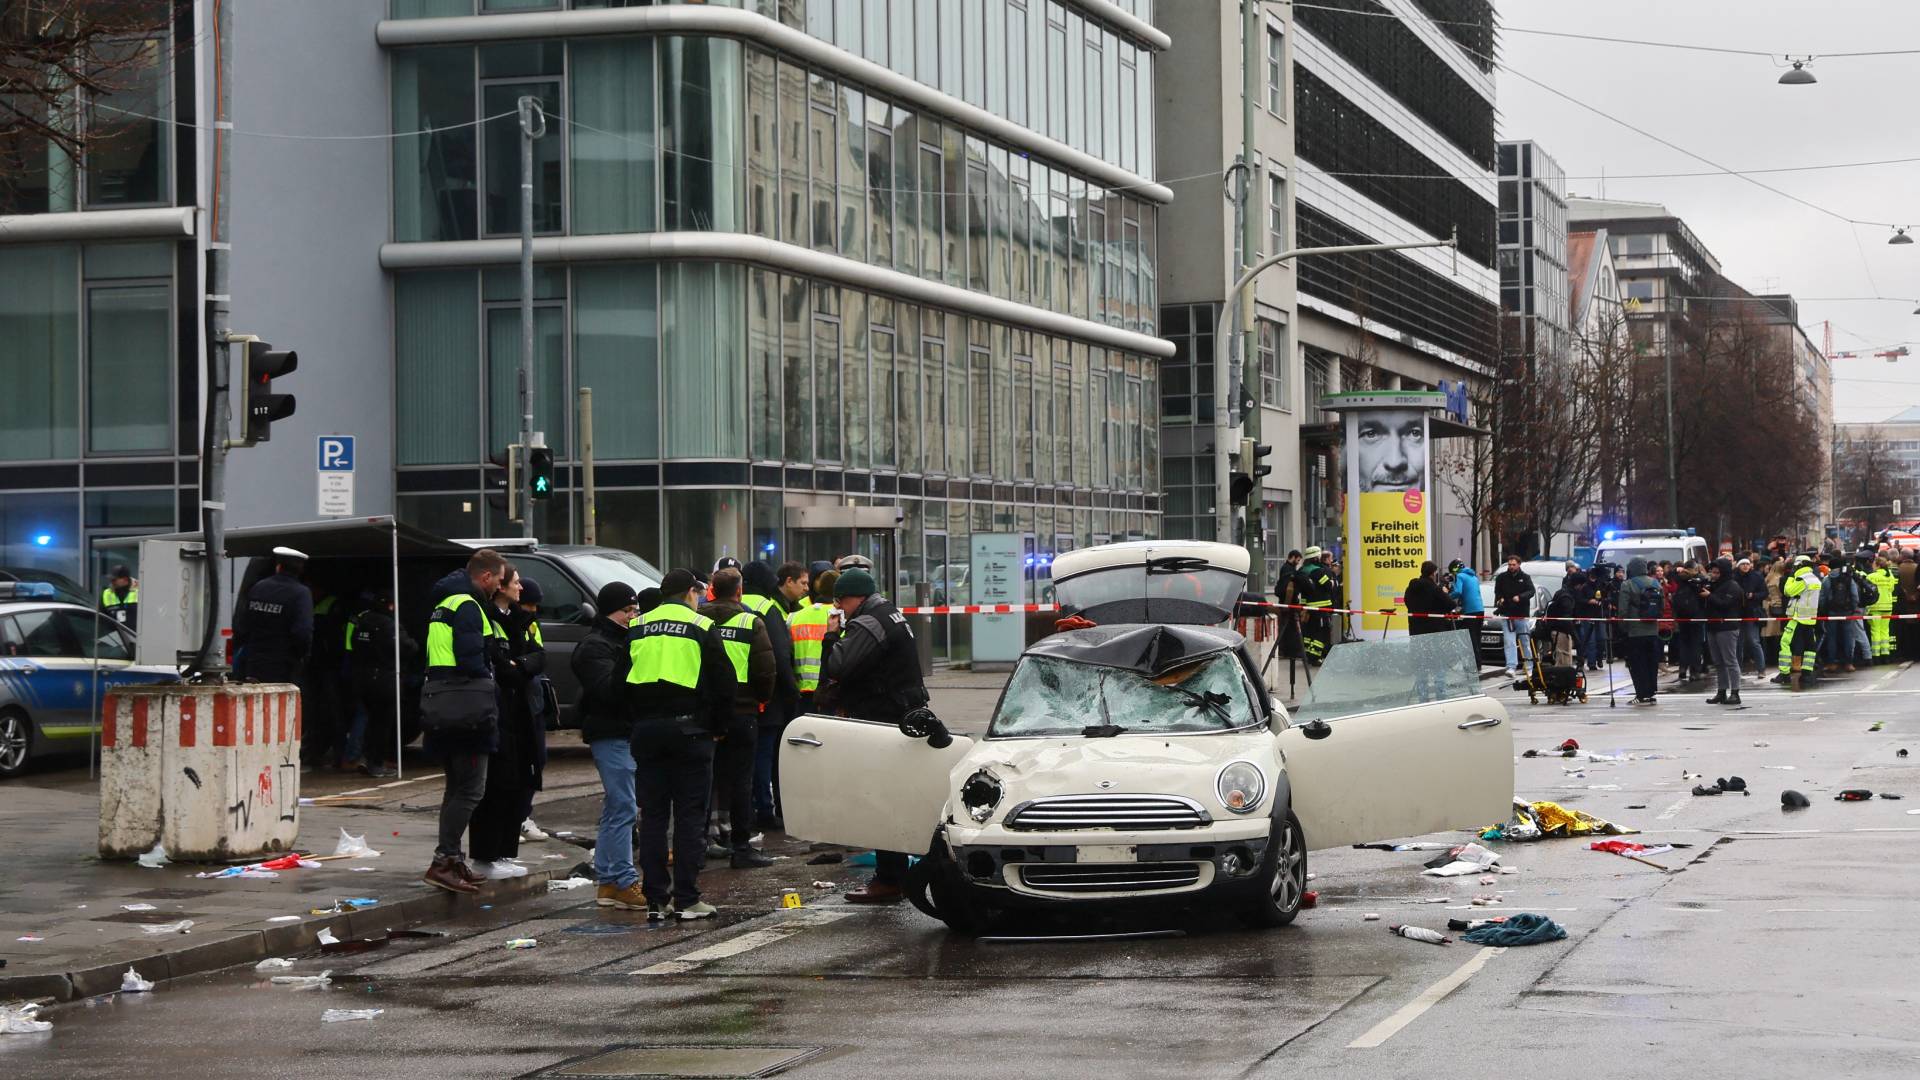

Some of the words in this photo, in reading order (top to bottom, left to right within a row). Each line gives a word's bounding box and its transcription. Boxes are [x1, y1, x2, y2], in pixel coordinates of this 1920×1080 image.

[323, 440, 344, 467] P
[1371, 521, 1419, 531] Freiheit
[1363, 533, 1401, 544] wählt
[1403, 533, 1425, 543] sich
[1367, 546, 1401, 556] nicht
[1403, 548, 1423, 556] von
[1374, 559, 1418, 569] selbst.
[249, 601, 283, 614] POLIZEI
[643, 622, 687, 635] POLIZEI
